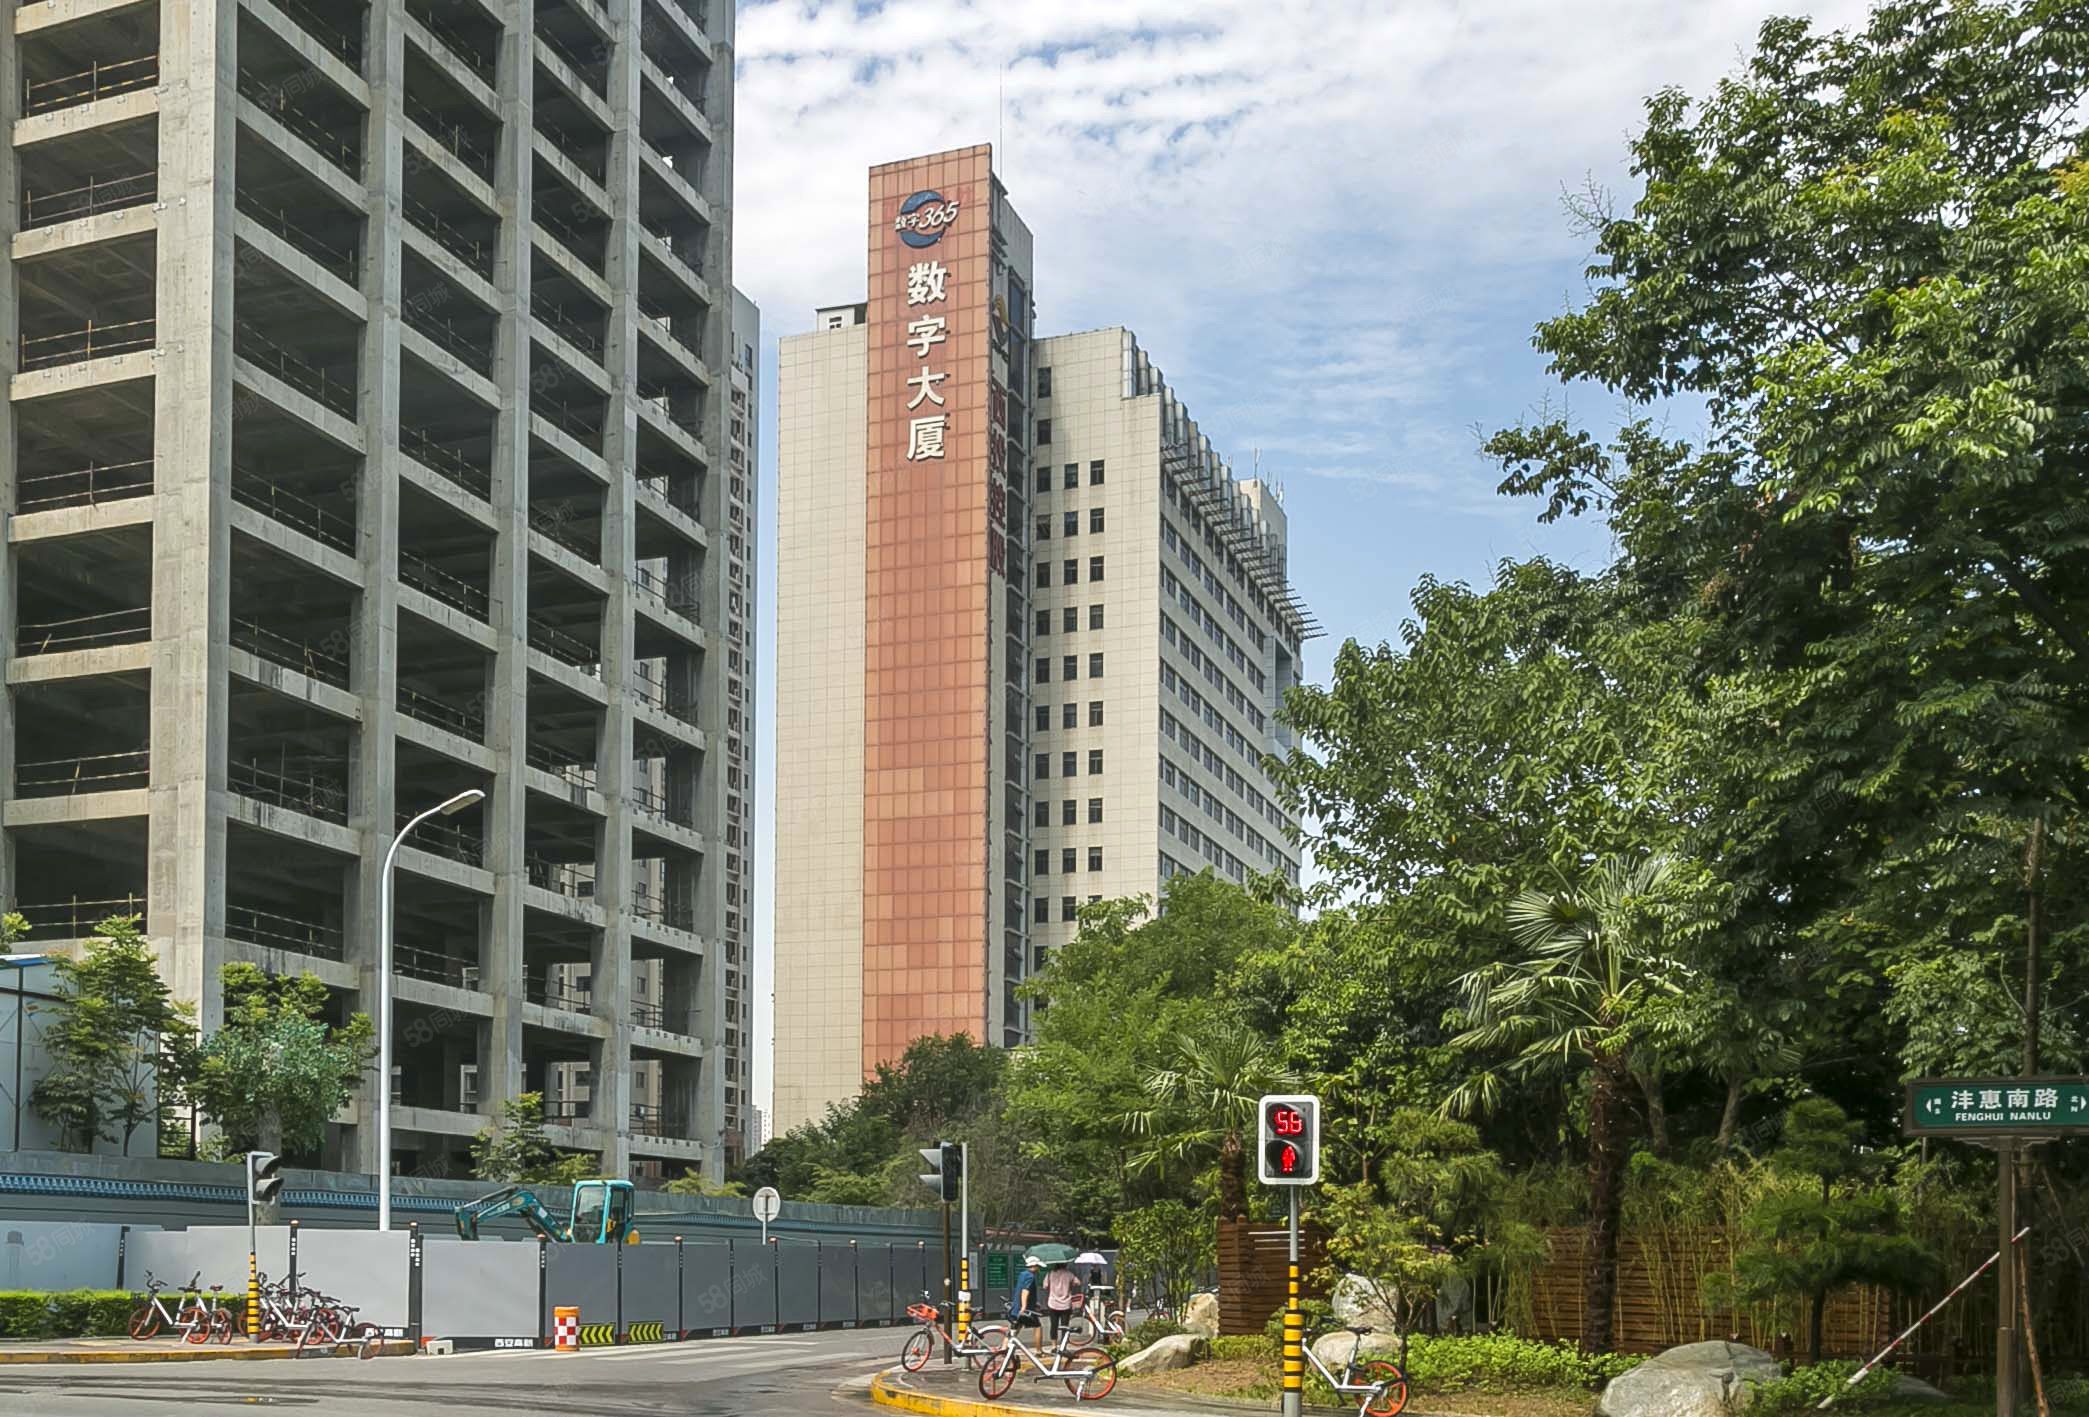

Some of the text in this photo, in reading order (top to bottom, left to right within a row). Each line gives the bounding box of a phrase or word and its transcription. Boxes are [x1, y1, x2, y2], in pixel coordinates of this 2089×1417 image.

[906, 260, 947, 461] 数字大厦
[1951, 1087, 2059, 1110] 沣惠南路
[1275, 1110, 1303, 1133] 56
[1954, 1111, 2052, 1122] FENGHUI NANLU
